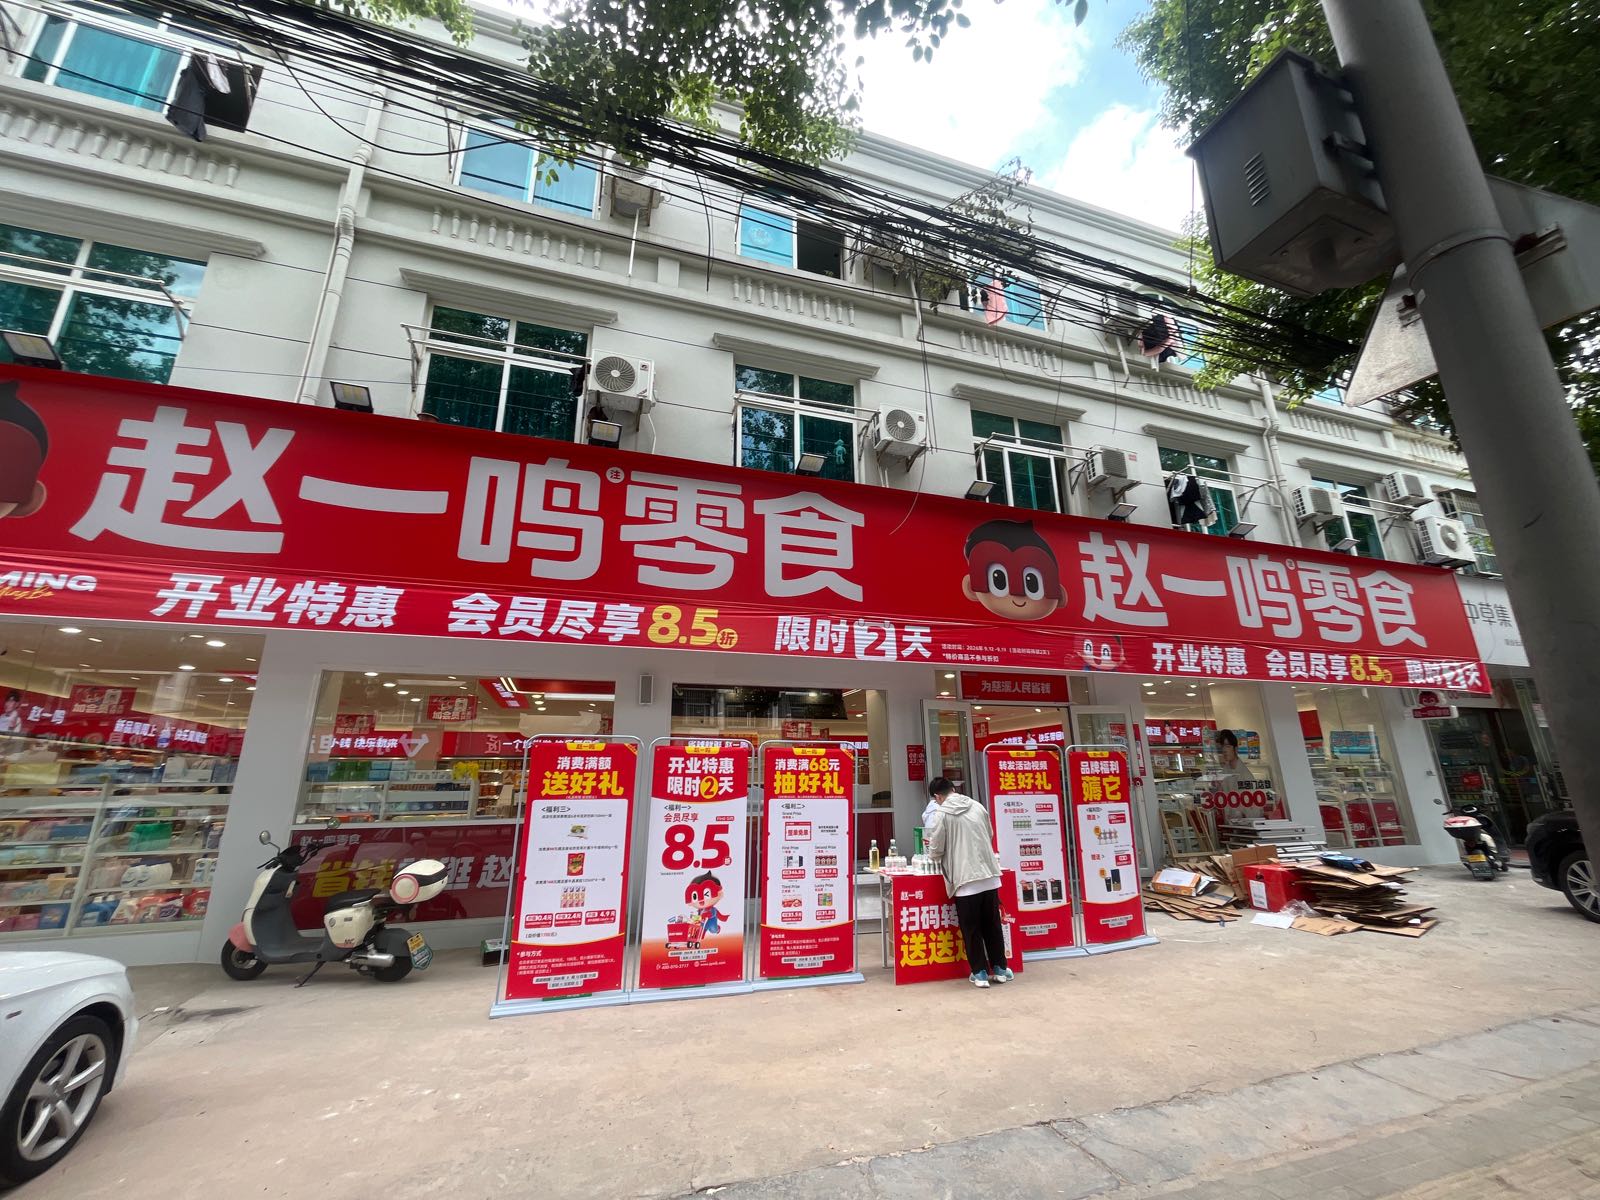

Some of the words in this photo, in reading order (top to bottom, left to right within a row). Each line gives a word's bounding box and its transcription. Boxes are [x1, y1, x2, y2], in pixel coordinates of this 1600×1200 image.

[68, 405, 865, 602] 赵一鸣零食
[1077, 531, 1427, 648] 赵一鸣零食
[151, 572, 404, 627] 开业特惠
[775, 616, 932, 661] 限时2天
[1152, 642, 1248, 676] 开业特惠
[557, 756, 613, 770] 消费满额
[668, 757, 734, 774] 开业特惠
[775, 758, 840, 772] 消费满68元
[999, 761, 1048, 771] 转发活动视频
[1080, 760, 1120, 775] 品牌福利
[541, 770, 625, 797] 送好礼
[667, 776, 734, 799] 限时2天
[773, 771, 845, 795] 抽好礼
[1000, 771, 1052, 791] 送好礼
[900, 890, 924, 901] 赵一鸣
